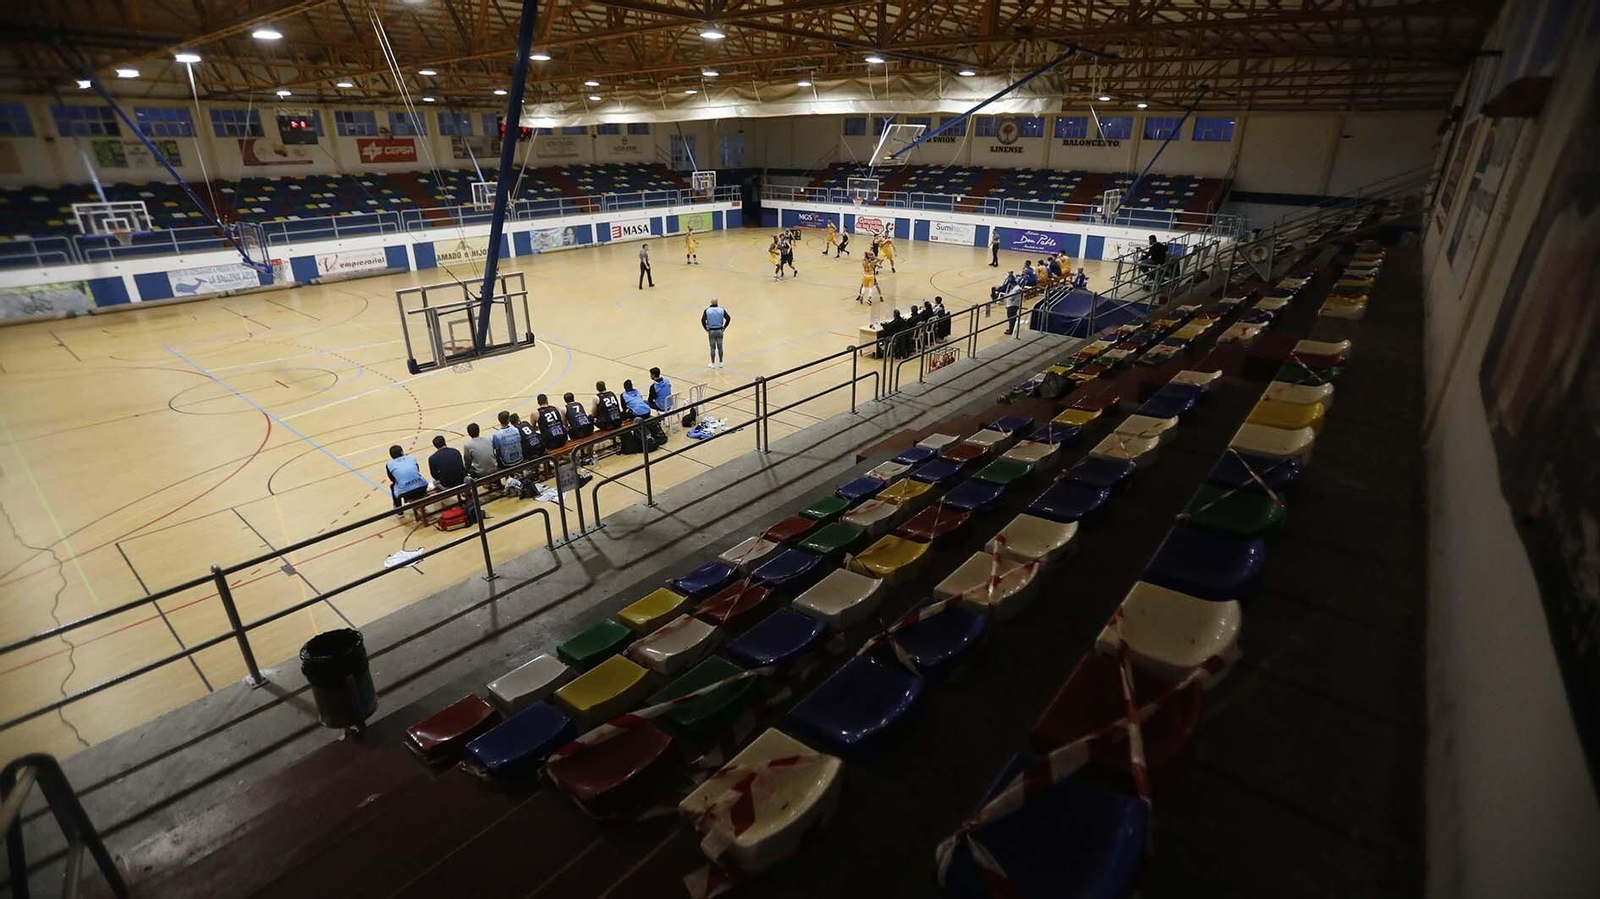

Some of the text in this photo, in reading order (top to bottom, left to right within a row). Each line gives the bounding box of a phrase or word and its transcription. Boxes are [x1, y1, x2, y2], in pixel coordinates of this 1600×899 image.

[384, 146, 414, 155] CEPSA
[990, 145, 1024, 154] LINENSE
[798, 213, 813, 221] MGS
[623, 224, 649, 236] MASA
[437, 251, 462, 262] AMADO
[471, 249, 489, 257] HIJO
[340, 256, 385, 268] empresarial
[603, 396, 617, 407] 24
[572, 405, 579, 413] 7
[544, 410, 558, 422] 21
[522, 426, 532, 435] 8
